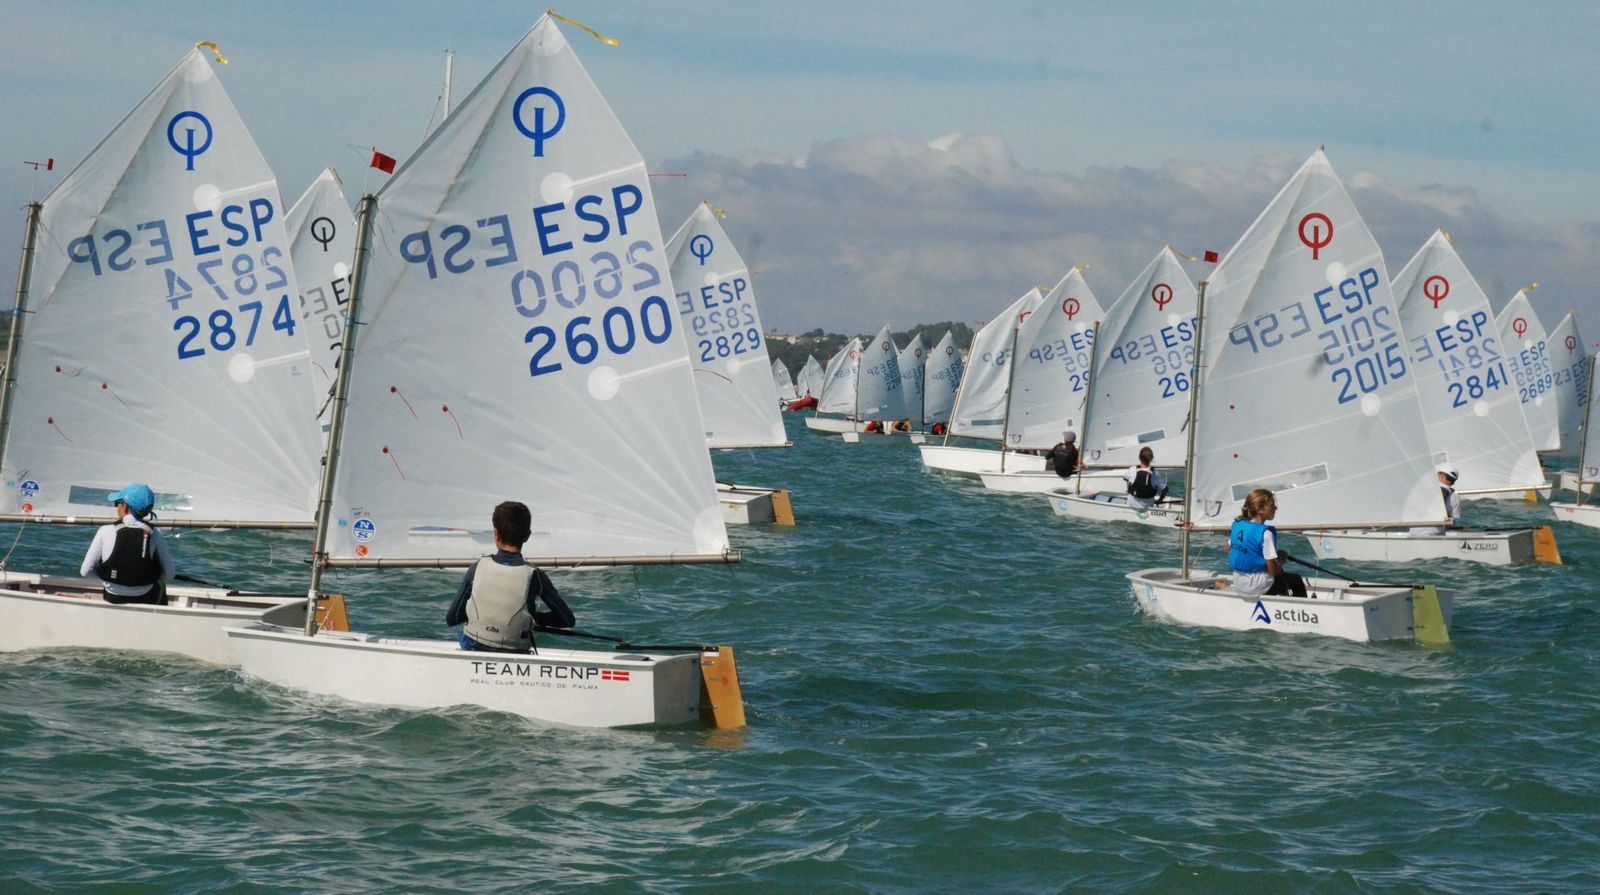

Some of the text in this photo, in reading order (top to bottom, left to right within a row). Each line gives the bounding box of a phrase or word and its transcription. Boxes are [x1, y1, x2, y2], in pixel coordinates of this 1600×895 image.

[186, 198, 274, 256] ESP
[532, 184, 642, 256] ESP
[701, 278, 746, 309] ESP
[1313, 268, 1379, 325] ESP
[174, 294, 296, 360] 2874
[525, 295, 672, 377] 2600
[699, 328, 760, 362] 2829
[1071, 329, 1094, 351] ES
[1436, 311, 1487, 352] ESP
[1520, 341, 1545, 366] ESP
[1159, 367, 1193, 398] 26
[1331, 343, 1406, 404] 2015
[1448, 362, 1508, 408] 2841
[1519, 374, 1552, 404] 2689
[1274, 608, 1319, 624] actiba
[471, 661, 599, 680] TEAM RCNP
